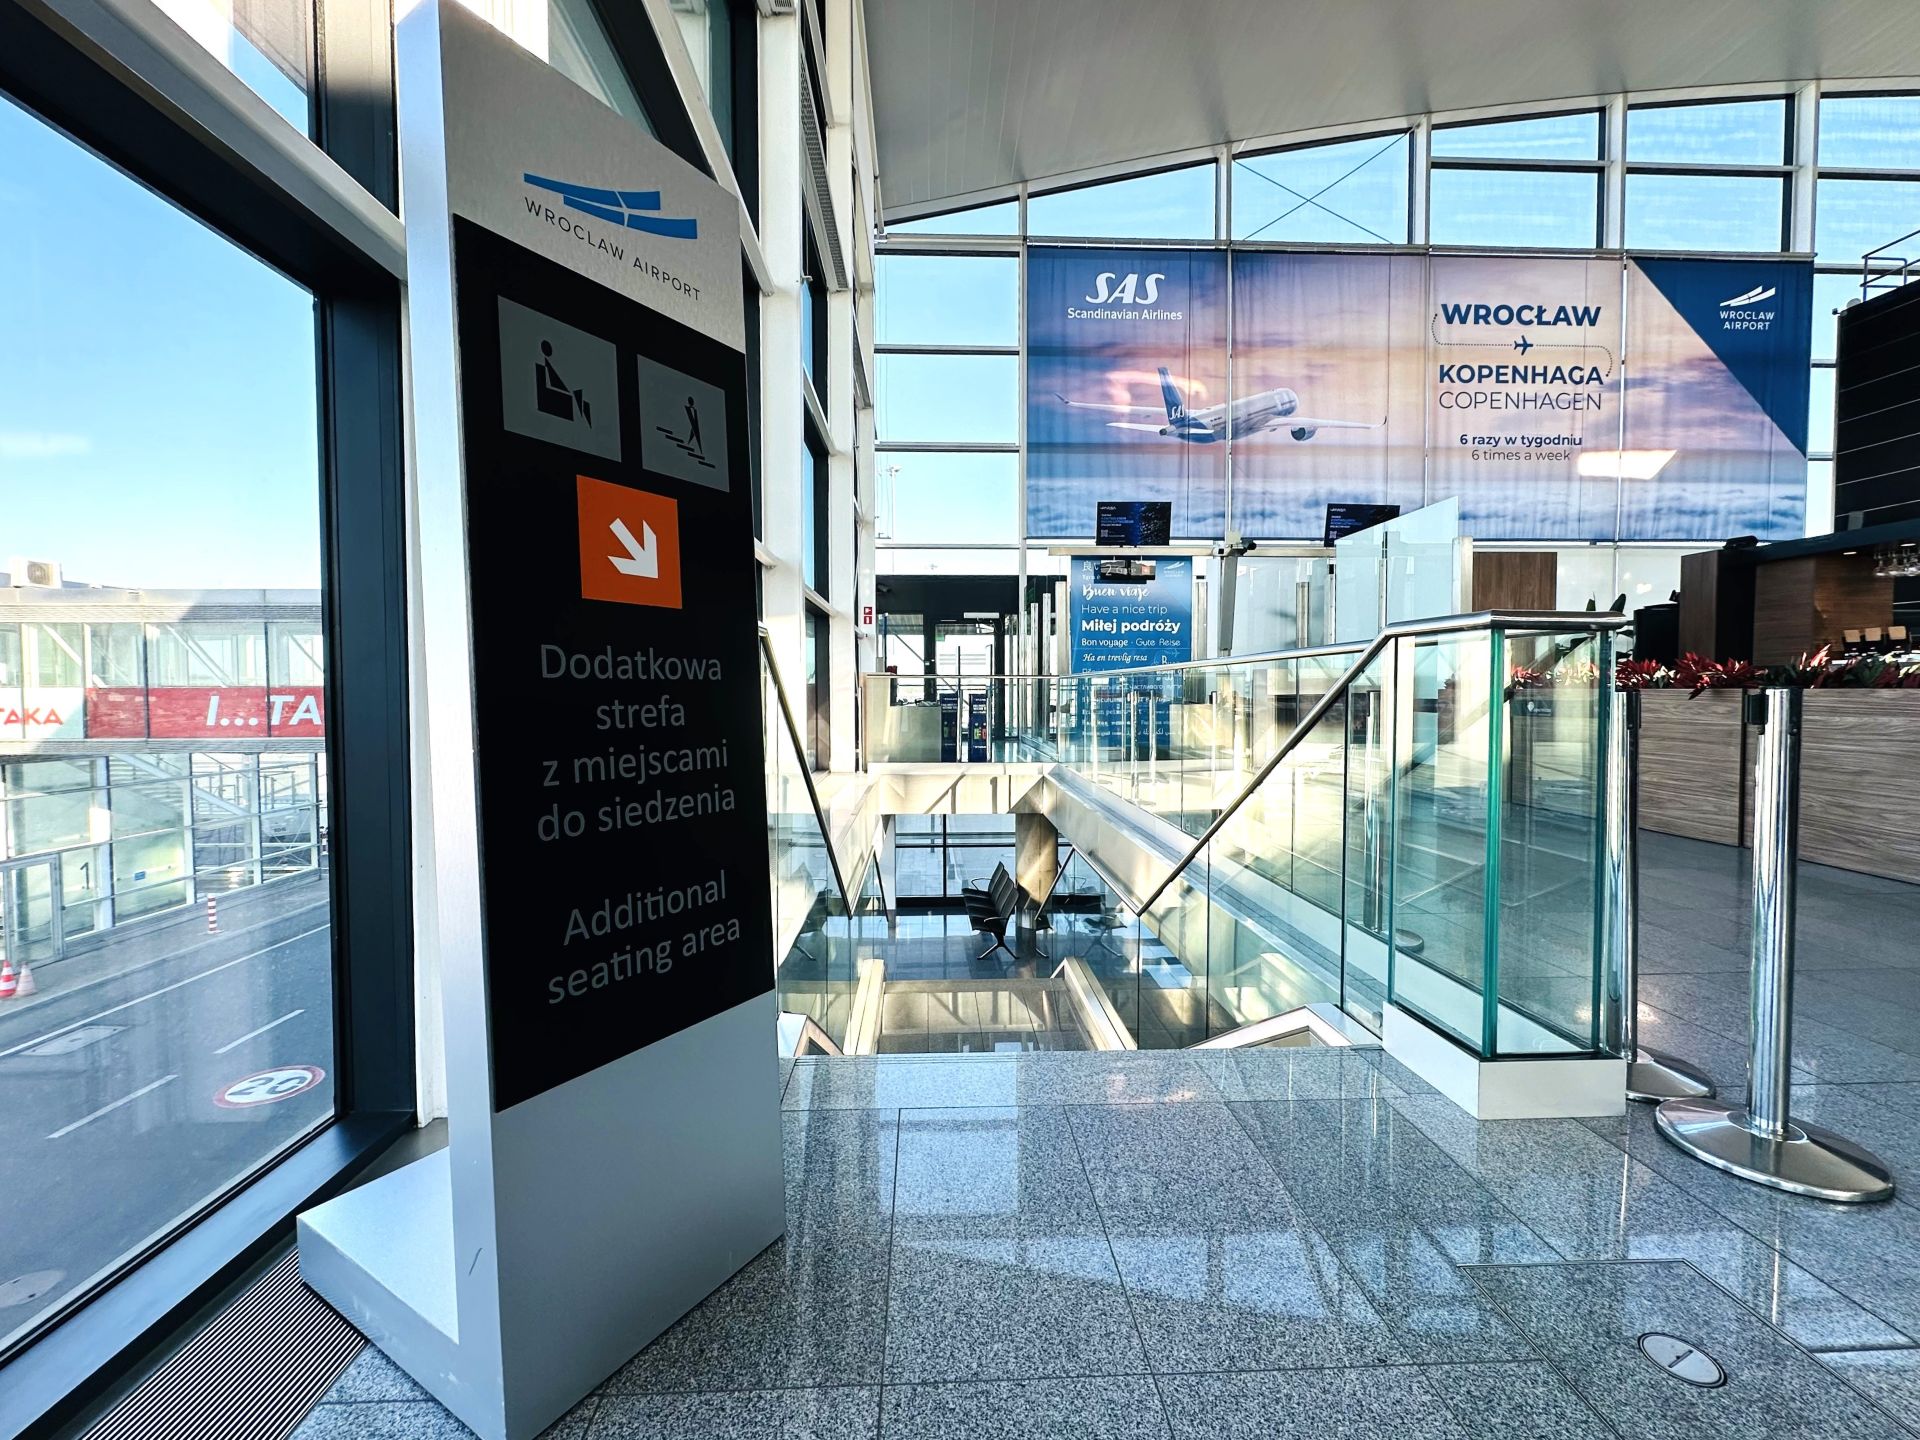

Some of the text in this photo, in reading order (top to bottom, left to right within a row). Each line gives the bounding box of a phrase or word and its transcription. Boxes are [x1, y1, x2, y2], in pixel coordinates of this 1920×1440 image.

[524, 196, 701, 301] WROCLAW AIRPORT
[1085, 272, 1165, 305] SAS
[1067, 307, 1183, 321] Scandinavian Airlines
[1441, 303, 1601, 327] WROCŁAW
[1720, 310, 1775, 321] WROCLAW
[1723, 321, 1771, 331] AIRPORT
[1439, 364, 1604, 386] KOPENHAGA
[1439, 391, 1602, 411] COPENHAGEN
[1460, 434, 1582, 450] 6 razy w tygodniu
[1471, 450, 1570, 461] 6 times a week
[1082, 583, 1150, 601] Buen viaje
[1081, 604, 1168, 616] Have a nice trip
[1081, 618, 1181, 634] Miłej podróży
[1081, 638, 1181, 648] Bon voyage Gute Reise
[540, 644, 722, 681] Dodatkowa
[596, 695, 685, 730] strefa
[543, 739, 728, 787] z miejscami
[537, 784, 735, 842] do siedzenia
[79, 862, 90, 890] 1
[563, 869, 727, 946] Additional
[548, 918, 740, 1005] seating area
[227, 1076, 308, 1096] 20
